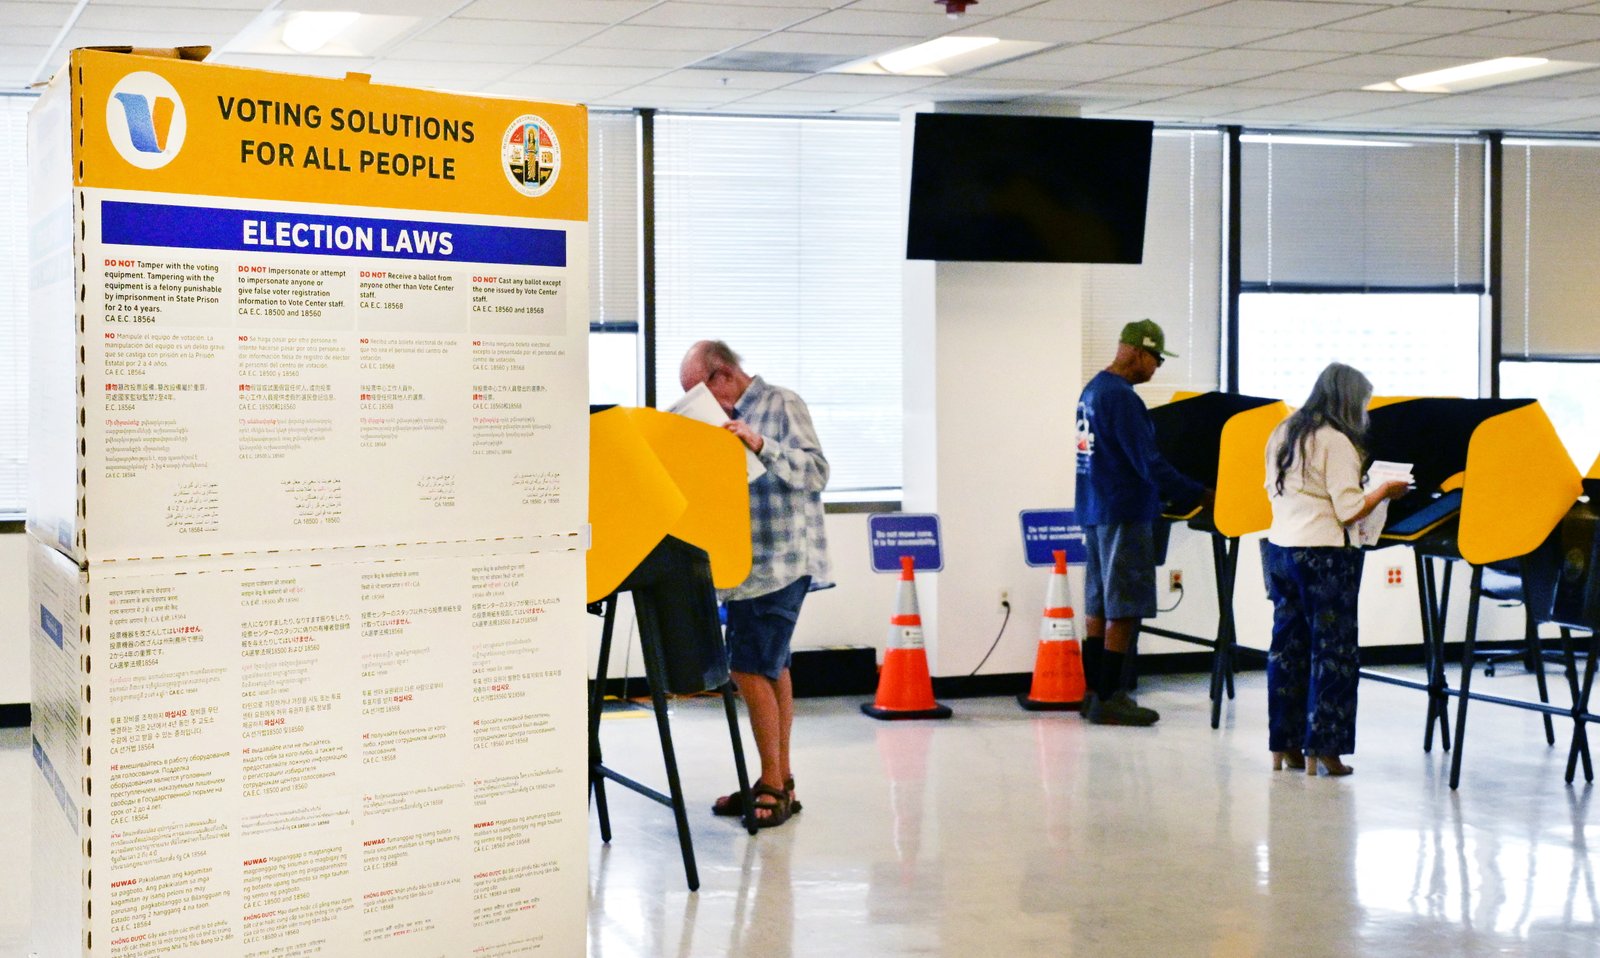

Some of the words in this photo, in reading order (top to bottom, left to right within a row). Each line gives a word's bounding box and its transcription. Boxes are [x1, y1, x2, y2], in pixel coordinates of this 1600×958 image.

[217, 95, 322, 128] VOTING
[329, 106, 475, 143] SOLUTIONS
[240, 139, 295, 167] FOR
[301, 145, 351, 172] ALL
[359, 150, 456, 180] PEOPLE
[242, 218, 372, 252] ELECTION
[380, 225, 454, 256] LAWS
[104, 259, 117, 267] DO
[118, 260, 135, 268] NOT
[137, 261, 164, 270] Tamper
[166, 262, 181, 270] with
[183, 262, 194, 270] the
[196, 263, 219, 273] voting
[238, 265, 249, 273] DO
[268, 266, 310, 276] Impersonate
[320, 269, 346, 278] attempt
[372, 271, 386, 279] NOT
[388, 272, 412, 280] Receive
[418, 273, 436, 281] ballot
[104, 271, 145, 280] equipment.
[147, 272, 185, 282] Tampering
[186, 273, 201, 281] with
[203, 274, 215, 282] the
[247, 276, 289, 285] impersonate
[290, 279, 315, 287] anyone
[360, 282, 383, 290] anyone
[403, 282, 417, 290] than
[513, 278, 523, 286] any
[542, 279, 561, 287] except
[104, 282, 143, 291] equipment
[145, 283, 151, 291] is
[159, 284, 182, 293] felony
[183, 285, 222, 294] punishable
[238, 287, 253, 296] give
[272, 288, 290, 296] voter
[292, 289, 330, 297] registration
[516, 287, 523, 296] by
[538, 288, 557, 296] Center
[104, 292, 113, 301] by
[115, 293, 165, 302] imprisonment
[167, 294, 174, 302] in
[176, 295, 195, 303] State
[196, 295, 219, 303] Prison
[238, 296, 278, 305] information
[288, 298, 303, 306] Vote
[305, 299, 327, 307] Center
[104, 303, 116, 311] for
[124, 304, 132, 312] to
[134, 304, 138, 312] 4
[384, 302, 404, 310] 18568
[250, 308, 262, 316] E.C.
[301, 309, 321, 317] 18560
[117, 315, 131, 323] E.C.
[133, 315, 156, 323] 18564
[876, 530, 885, 538] Do
[898, 530, 915, 538] move
[873, 538, 880, 546] It
[887, 538, 896, 546] for
[168, 757, 188, 766] работу
[473, 821, 494, 829] HUWAG
[363, 839, 386, 847] HUWAG
[243, 857, 268, 866] HUWAG
[110, 878, 137, 888] HUWAG
